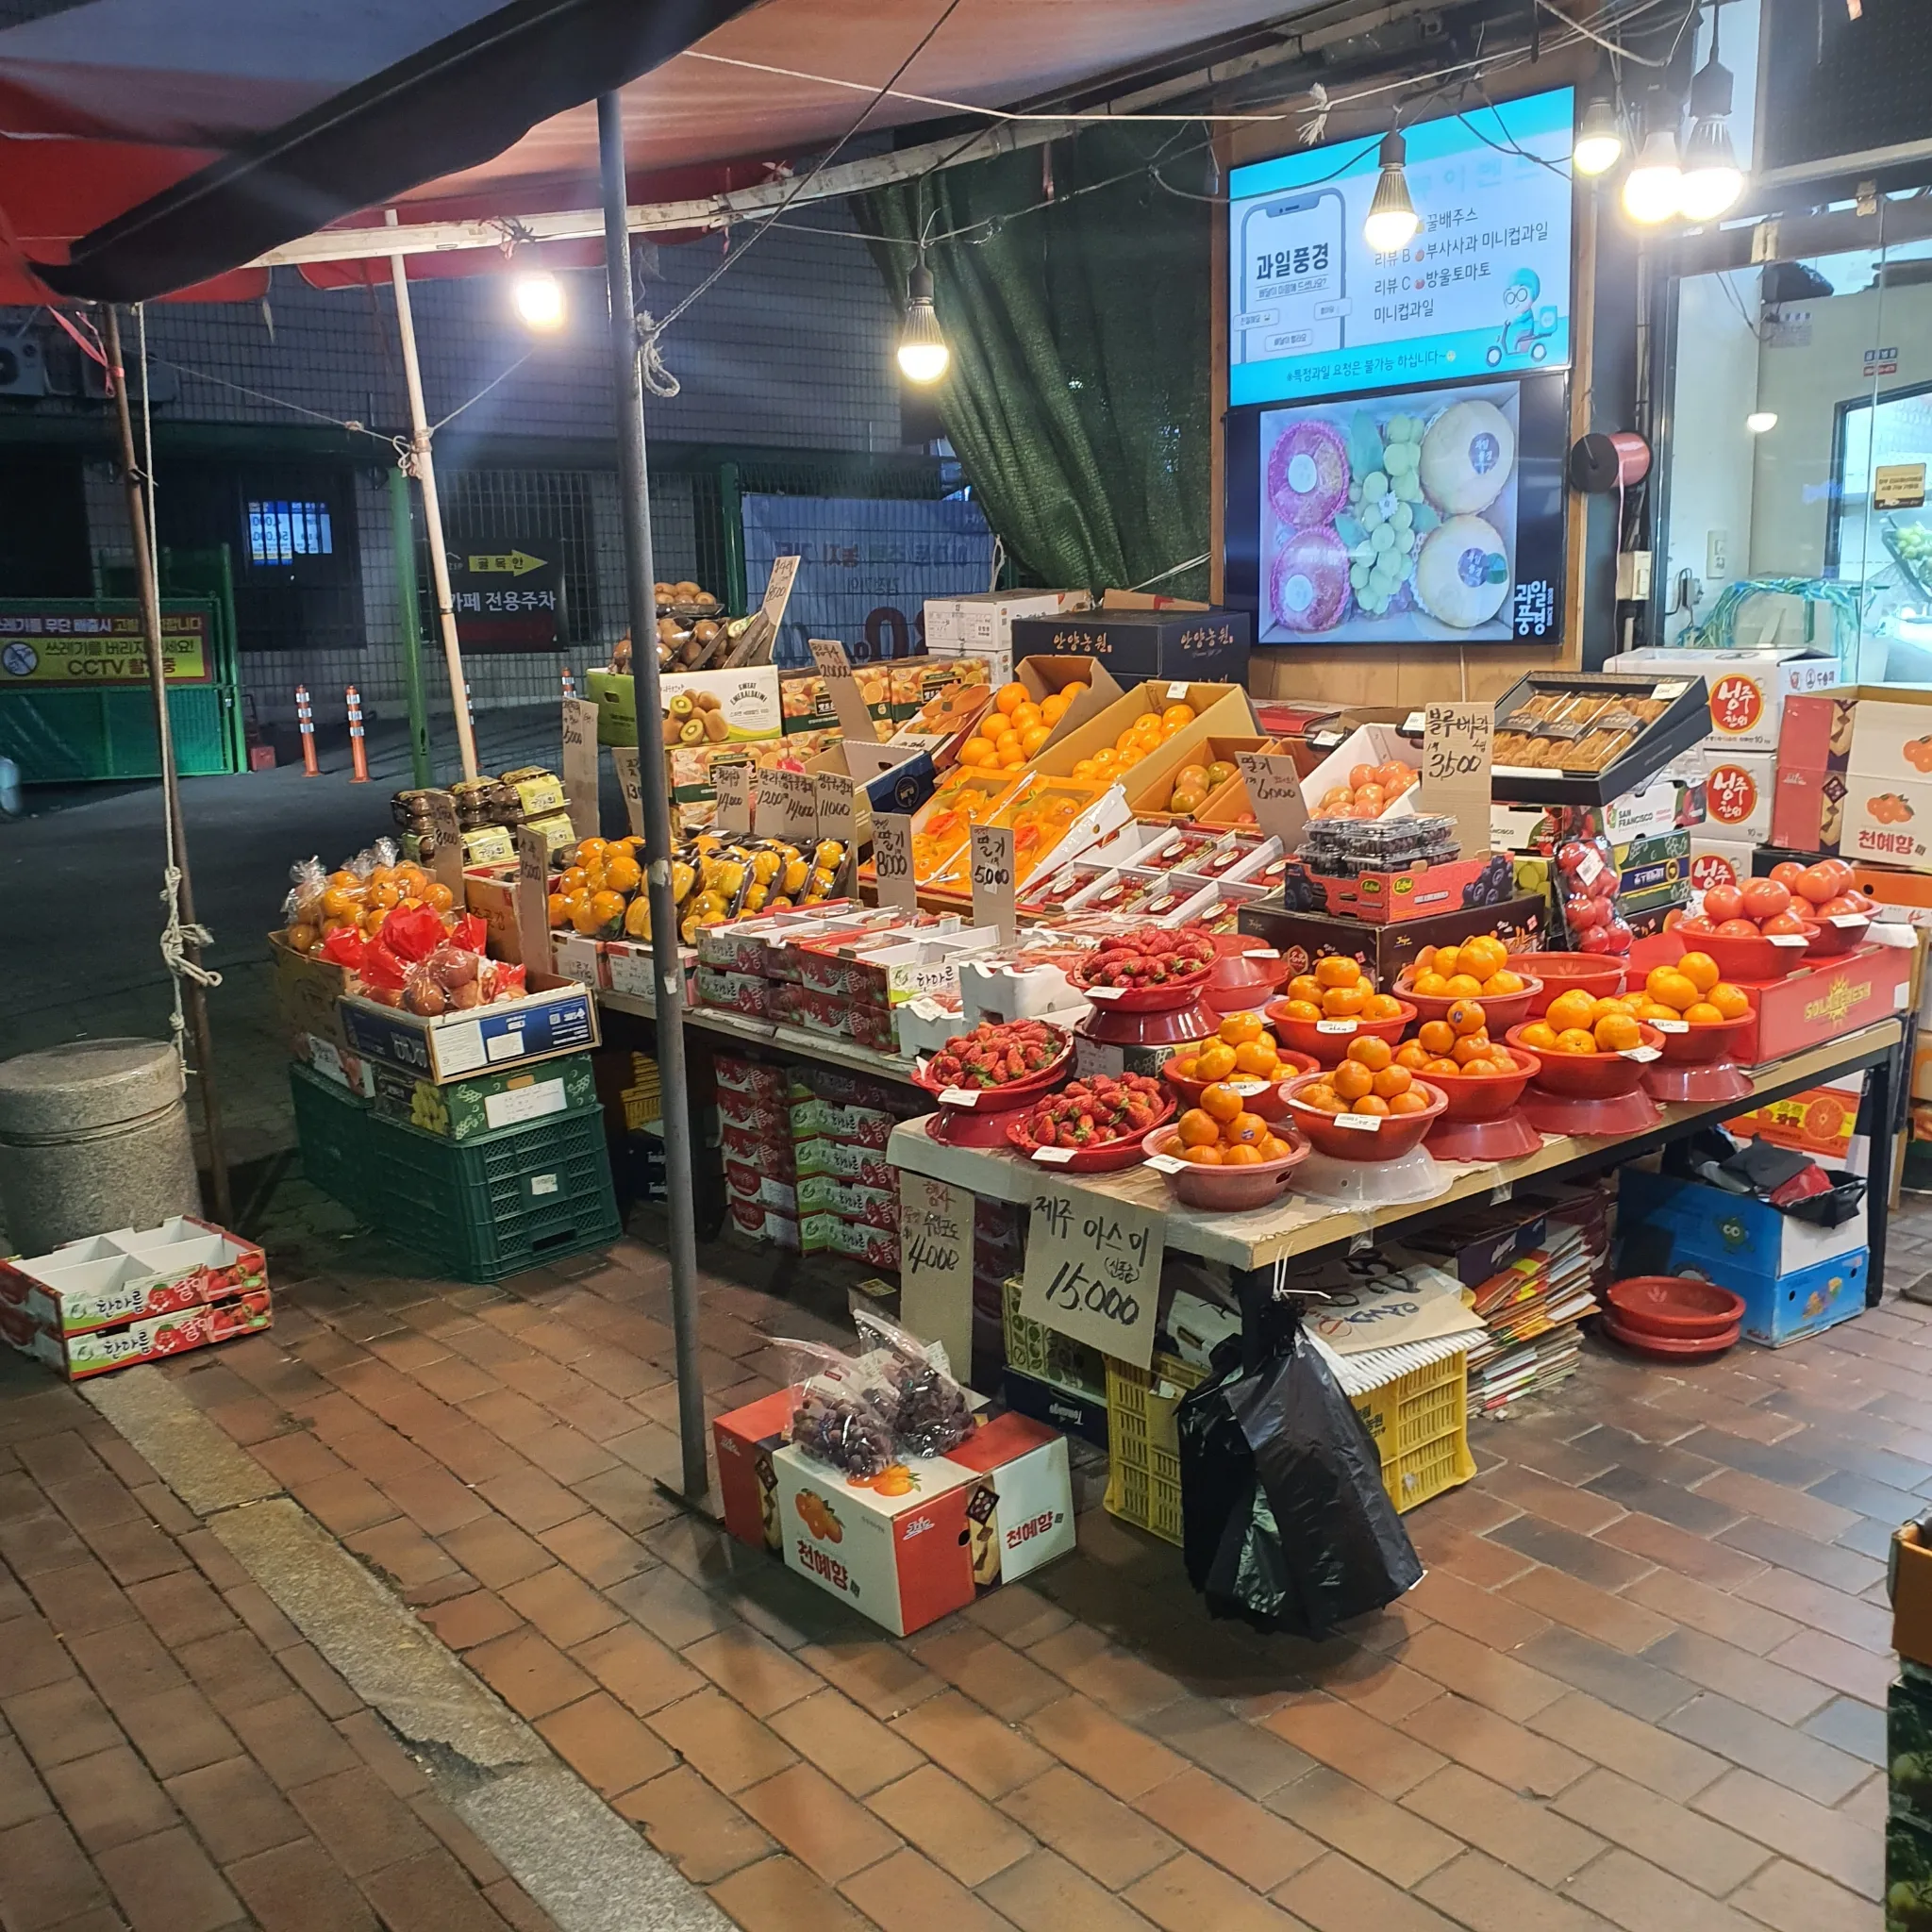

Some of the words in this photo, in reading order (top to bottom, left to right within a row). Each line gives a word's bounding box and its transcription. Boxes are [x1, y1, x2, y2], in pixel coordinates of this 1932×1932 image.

[1426, 207, 1478, 232] 꿀배주스
[1402, 248, 1411, 264] B
[1425, 237, 1479, 259] 부사사과
[1482, 221, 1548, 249] 미니컵과일
[1257, 242, 1330, 280] 과일풍경
[1374, 275, 1397, 296] 리뷰
[1402, 275, 1411, 291] C
[1425, 261, 1491, 291] 방울토마토
[1374, 298, 1434, 325] 미니컵과일
[1333, 357, 1362, 376] 요청은
[1364, 354, 1394, 373] 불가능
[45, 618, 71, 632] 무단
[1180, 623, 1229, 650] 안양농원
[45, 641, 102, 657] 쓰레기를
[1053, 631, 1108, 654] 안양농원
[68, 658, 124, 676] CCTV
[1717, 680, 1756, 714] 성주
[1427, 708, 1489, 740] 블루베리
[1241, 756, 1274, 775] 딸기
[1711, 769, 1750, 807] 성주
[1618, 808, 1632, 820] SAN
[1618, 812, 1654, 828] FRANCISCO
[877, 831, 905, 852] 딸기
[976, 836, 1006, 858] 딸기
[1858, 829, 1916, 856] 천혜향
[1034, 1196, 1076, 1239] 제주
[95, 1289, 146, 1319] 한아름
[104, 1329, 152, 1360] 한아름
[1006, 1511, 1055, 1551] 천혜향
[796, 1538, 850, 1592] 천혜향
